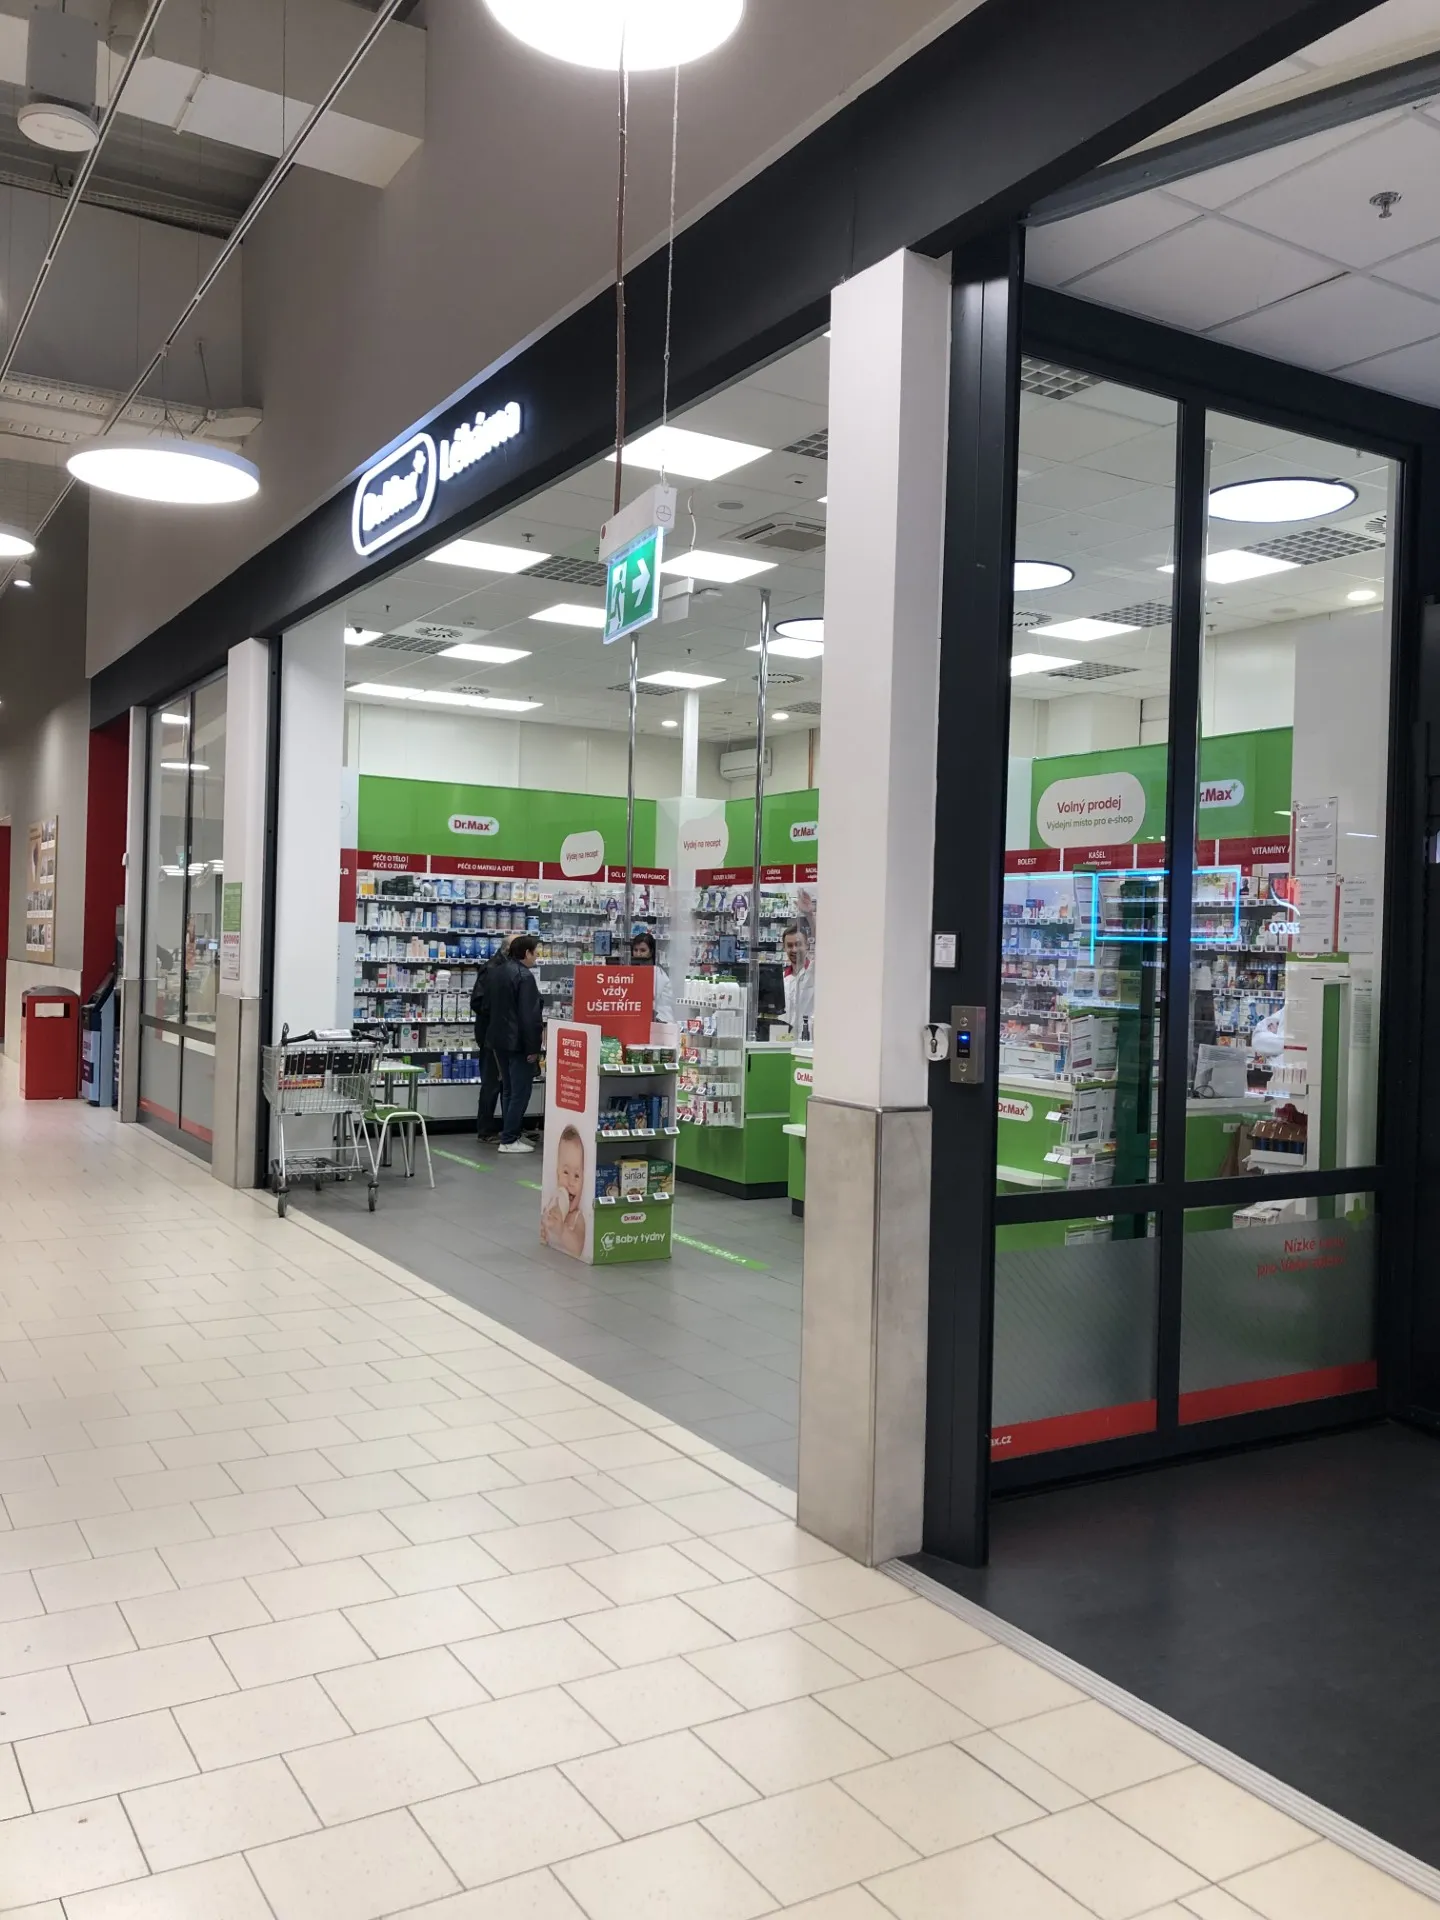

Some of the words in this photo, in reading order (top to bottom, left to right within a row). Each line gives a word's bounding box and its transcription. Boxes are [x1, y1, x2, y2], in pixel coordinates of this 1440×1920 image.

[1056, 798, 1086, 814] Volný
[1088, 795, 1122, 813] prodej
[454, 819, 490, 832] Dr.Max
[1073, 817, 1093, 828] místo
[1094, 817, 1106, 828] pro
[1107, 814, 1134, 824] e-shop
[792, 826, 815, 837] Dr.Max
[705, 839, 721, 849] recept
[585, 850, 598, 859] recept
[1088, 851, 1106, 859] KAŠEL
[1251, 845, 1287, 855] VITAMÍNY
[502, 864, 515, 872] DÍTĚ
[596, 973, 604, 984] S
[607, 973, 634, 984] námi
[602, 985, 628, 998] vždy
[586, 999, 642, 1012] UŠETŘÍTE
[564, 1048, 570, 1056] SE
[796, 1071, 813, 1082] Dr.Ma
[998, 1102, 1025, 1116] Dr.Max
[624, 1171, 646, 1180] sinlac
[615, 1233, 639, 1244] Baby
[640, 1231, 666, 1243] týdny
[1284, 1238, 1316, 1253] Nízké
